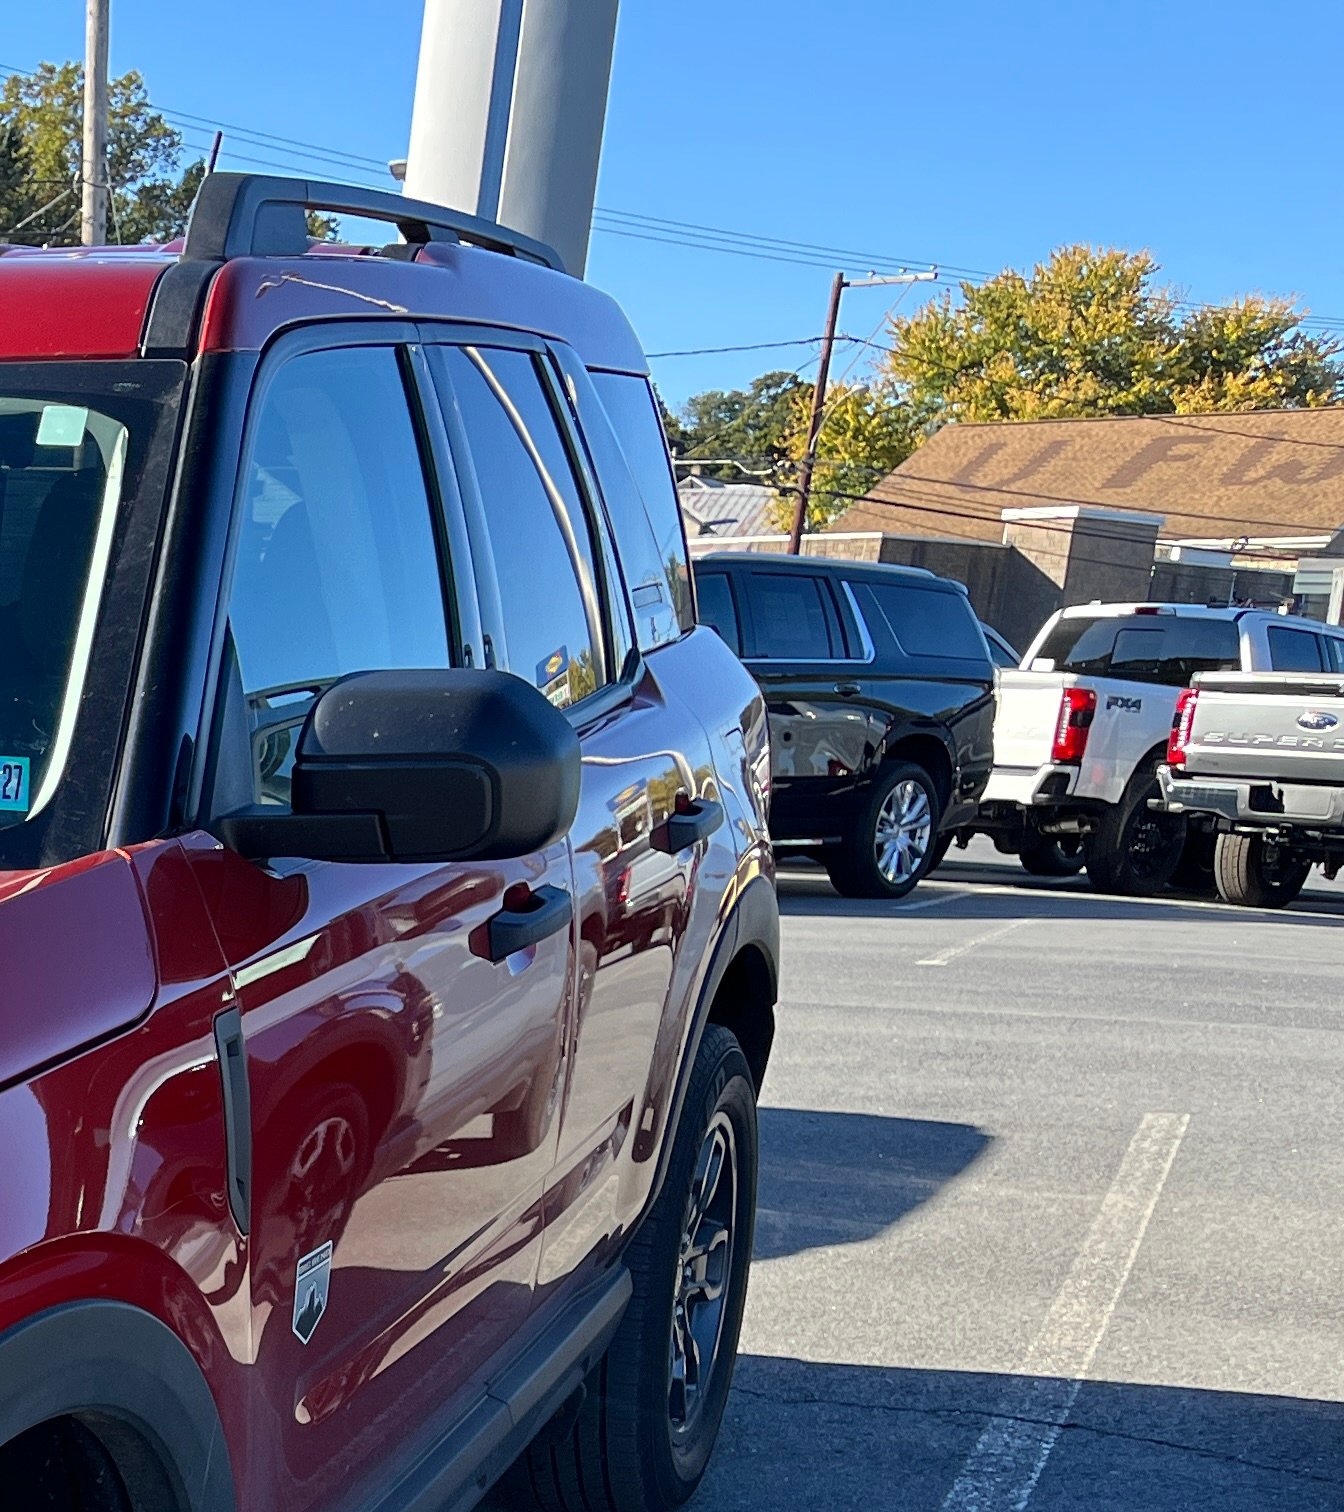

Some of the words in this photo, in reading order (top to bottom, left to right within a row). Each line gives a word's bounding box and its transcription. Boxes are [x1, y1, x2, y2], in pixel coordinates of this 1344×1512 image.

[1106, 696, 1142, 710] FX4
[1203, 732, 1324, 749] SUPER
[1, 764, 23, 800] 27
